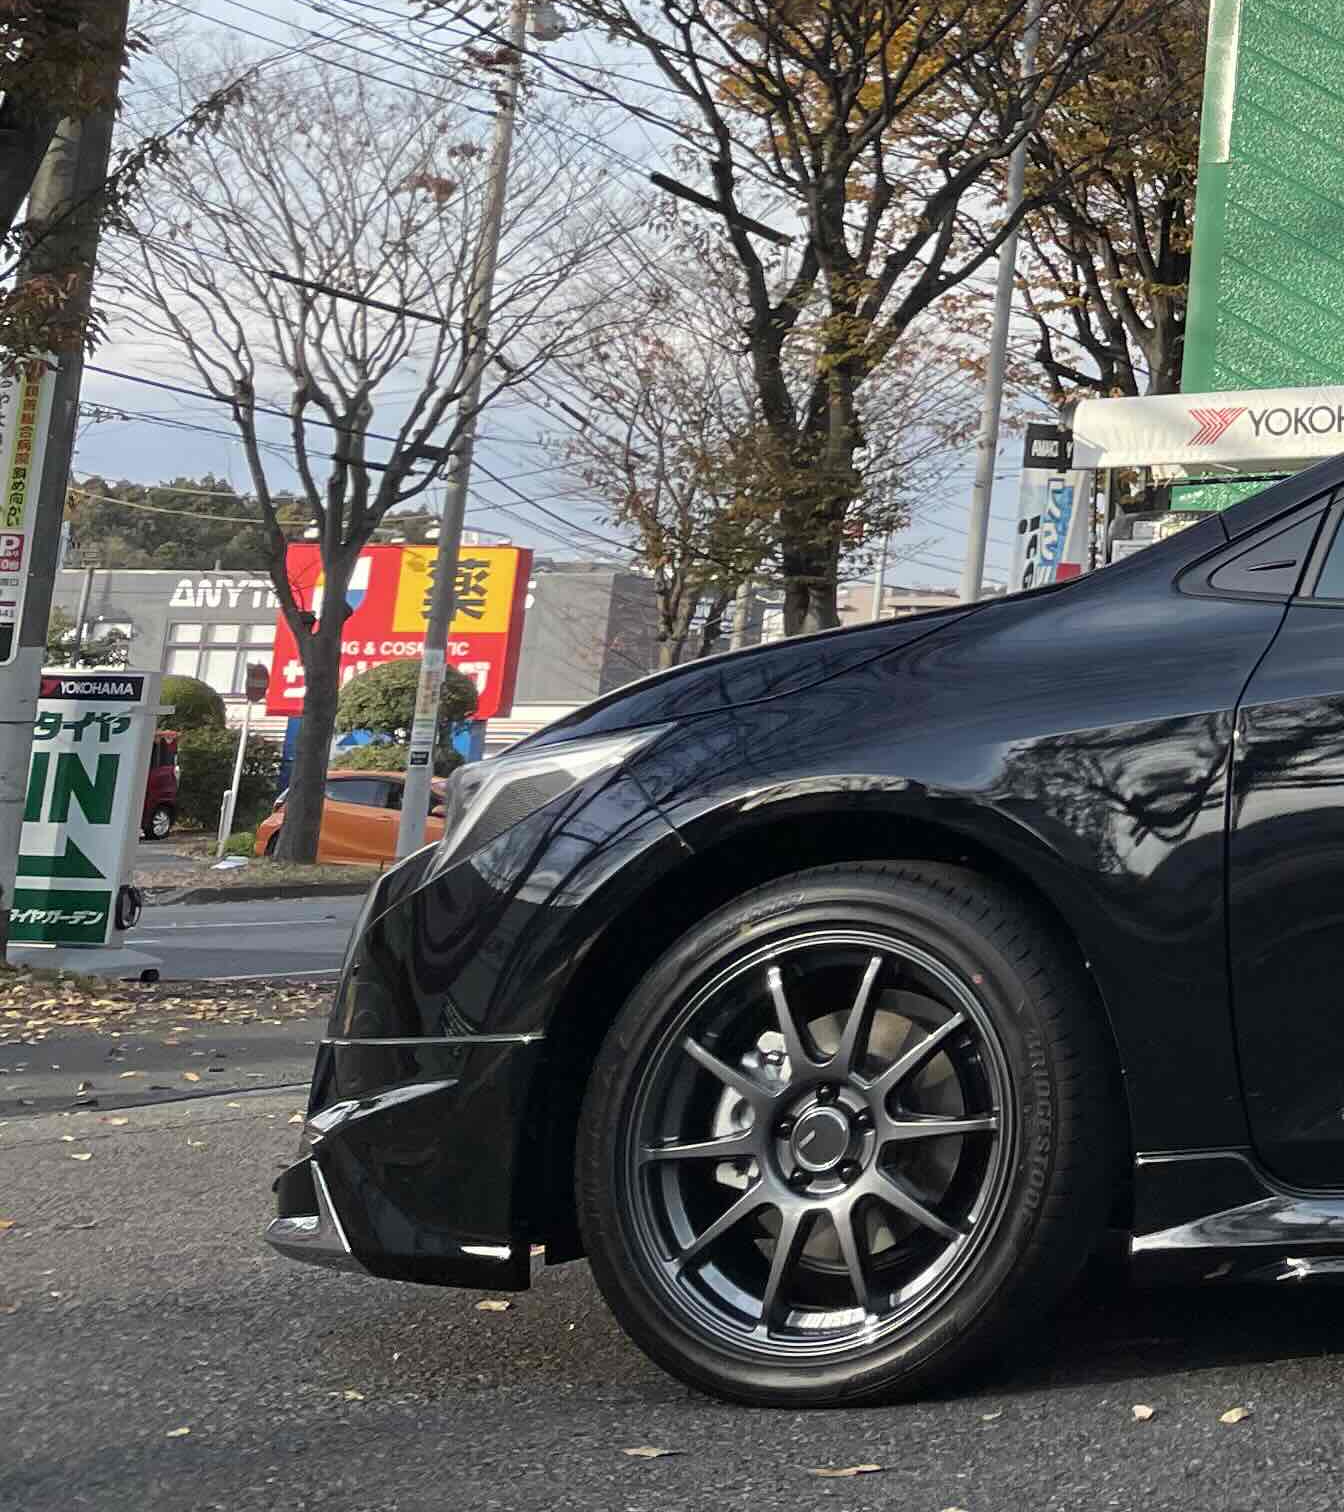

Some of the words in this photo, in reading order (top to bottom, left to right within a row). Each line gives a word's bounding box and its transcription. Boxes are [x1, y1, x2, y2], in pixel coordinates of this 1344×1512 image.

[60, 680, 135, 697] YOKOHAMA
[33, 711, 132, 743] タイヤ
[23, 751, 121, 825] IN
